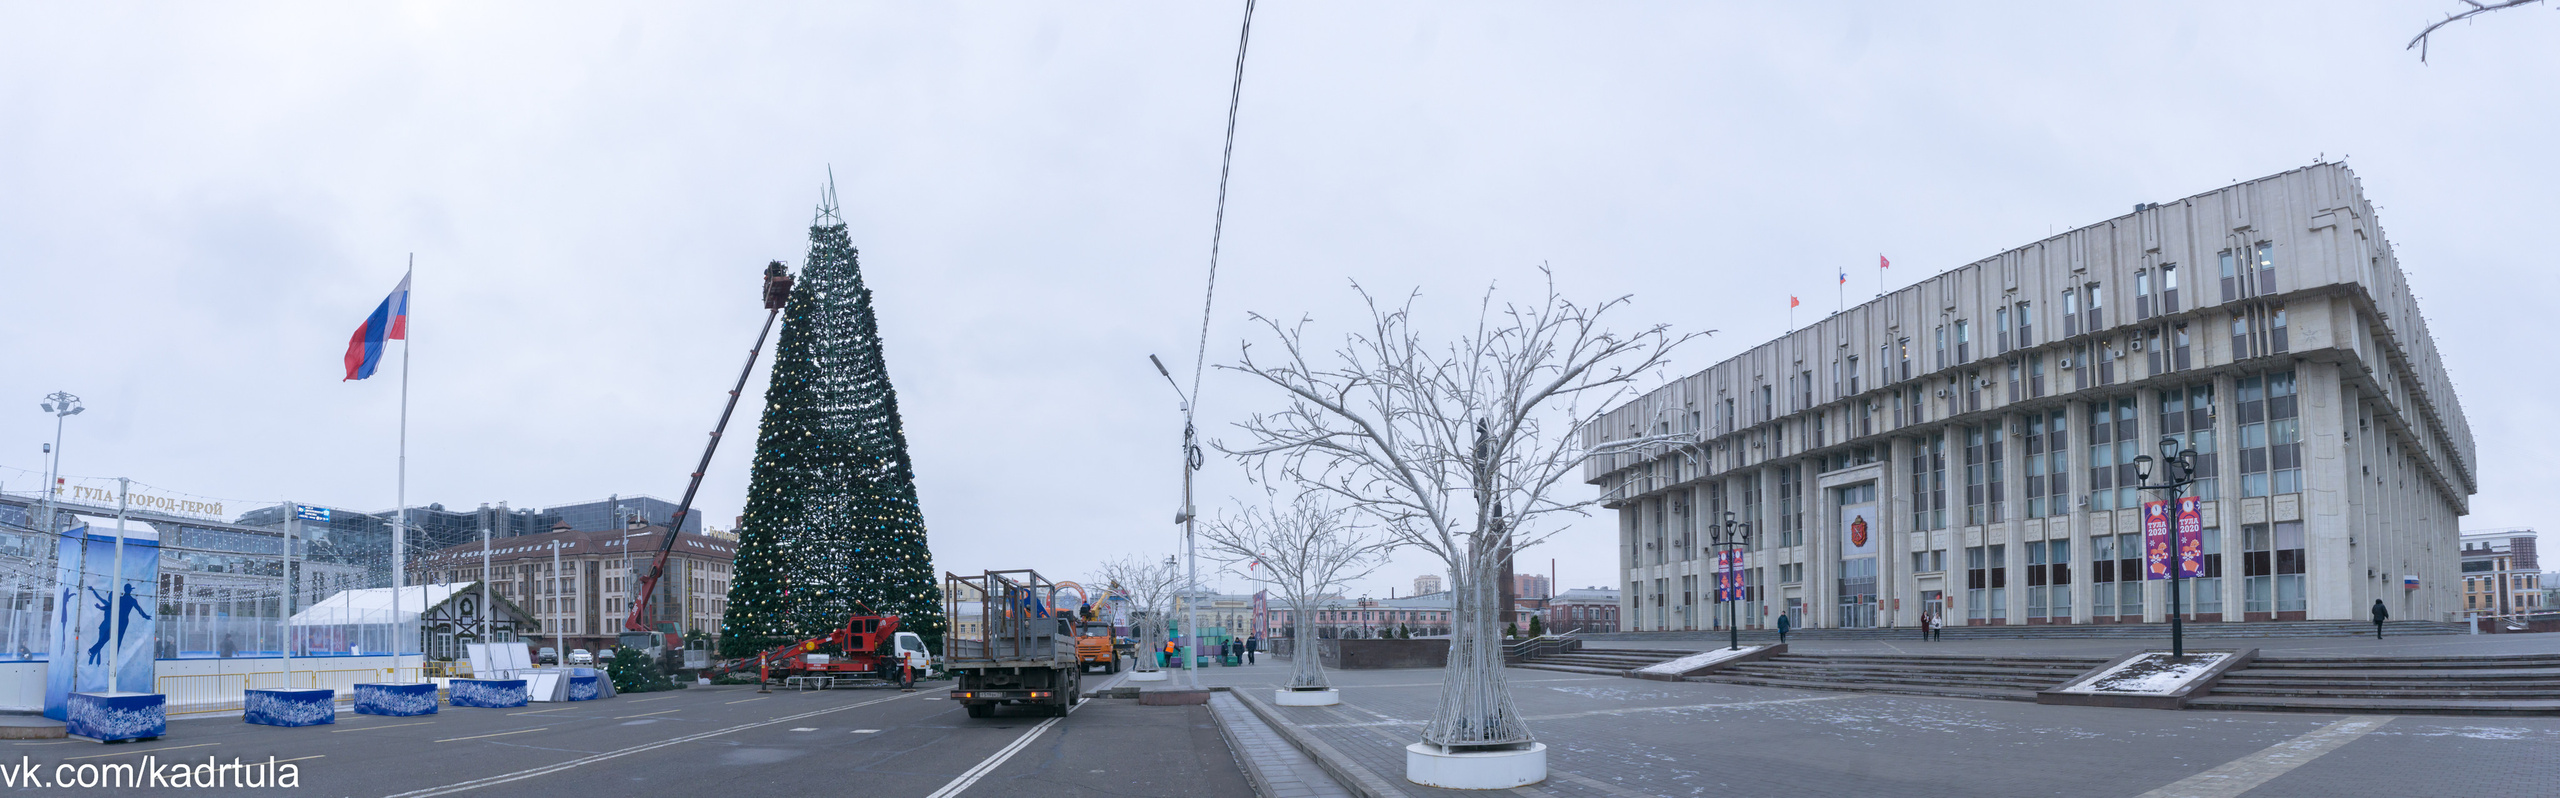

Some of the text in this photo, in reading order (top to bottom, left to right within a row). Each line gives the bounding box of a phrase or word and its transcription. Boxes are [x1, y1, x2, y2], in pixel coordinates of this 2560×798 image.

[73, 485, 114, 502] ТУЛА
[128, 493, 223, 515] ГОРОД-ГЕРОЙ
[2148, 528, 2167, 537] 2020
[2180, 524, 2199, 533] 2020
